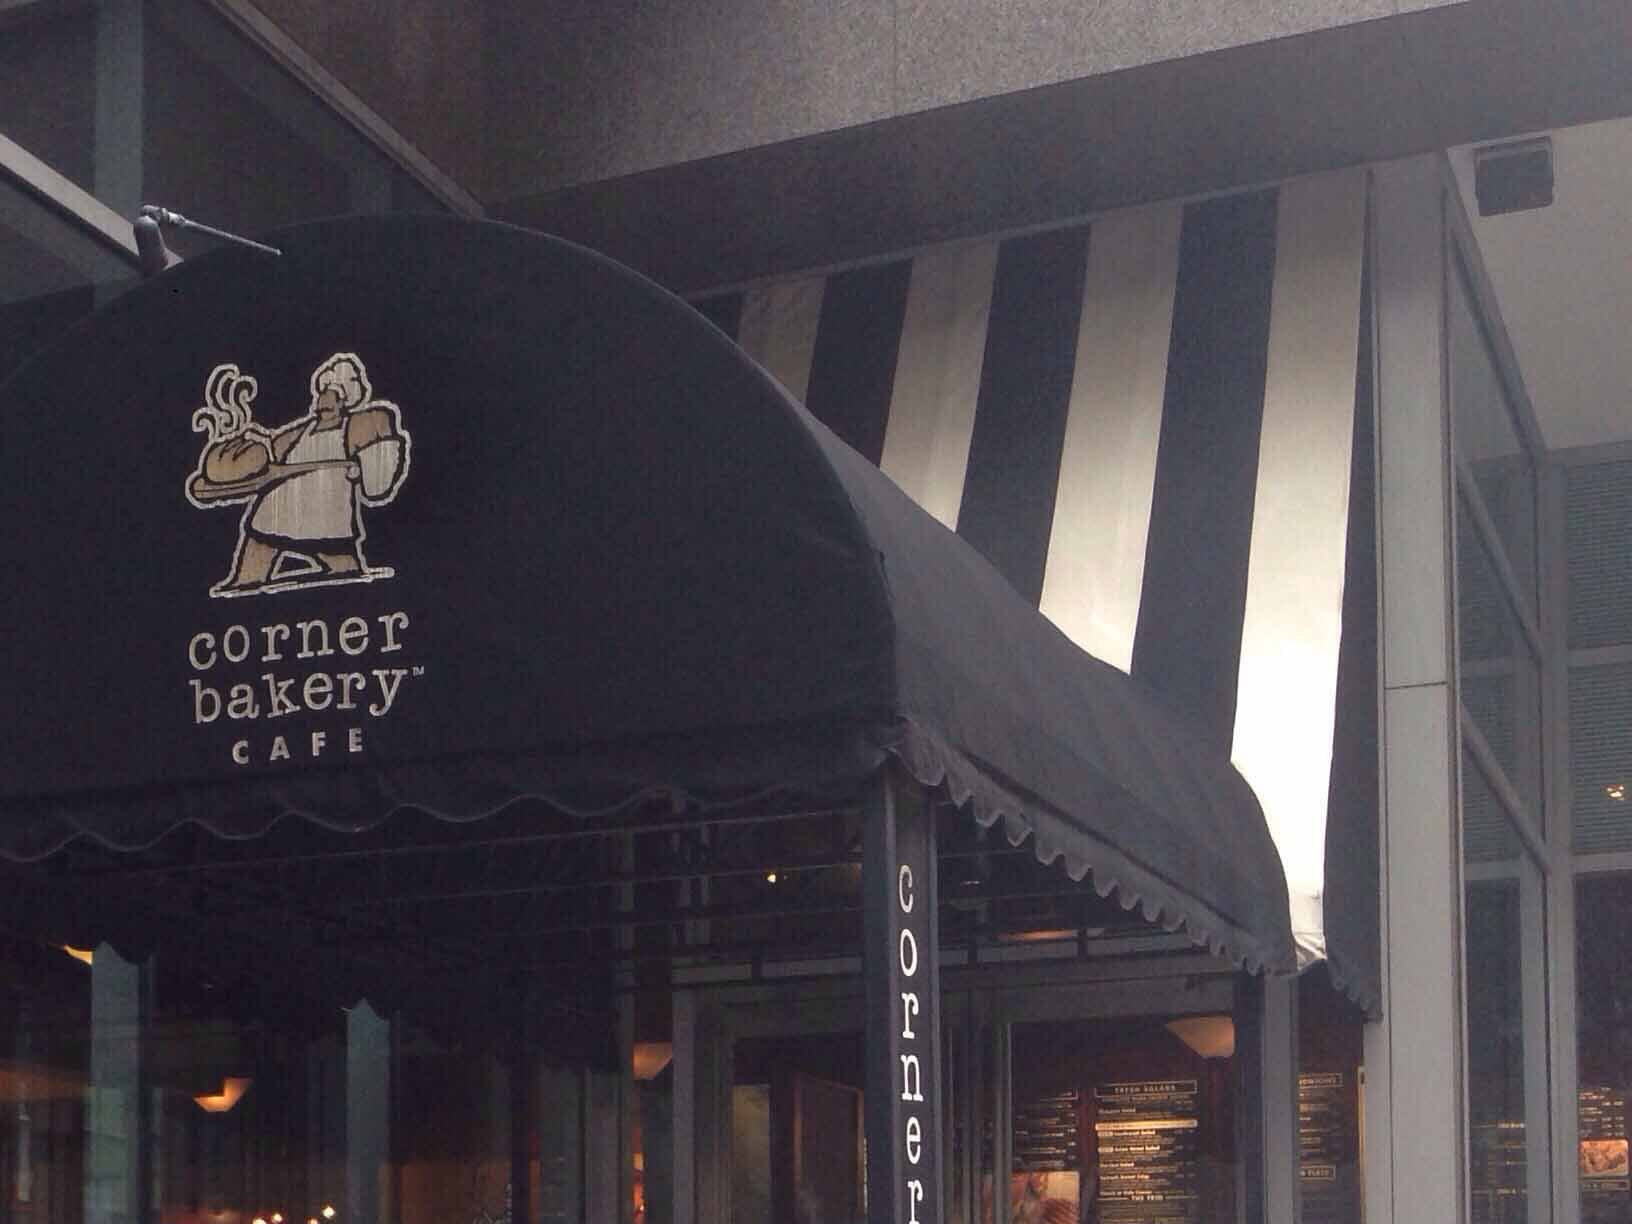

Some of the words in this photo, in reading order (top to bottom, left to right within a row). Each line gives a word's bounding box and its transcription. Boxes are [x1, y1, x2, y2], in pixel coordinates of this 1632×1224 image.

[189, 611, 409, 671] corner
[189, 667, 408, 723] bakery
[232, 728, 363, 764] CAFE
